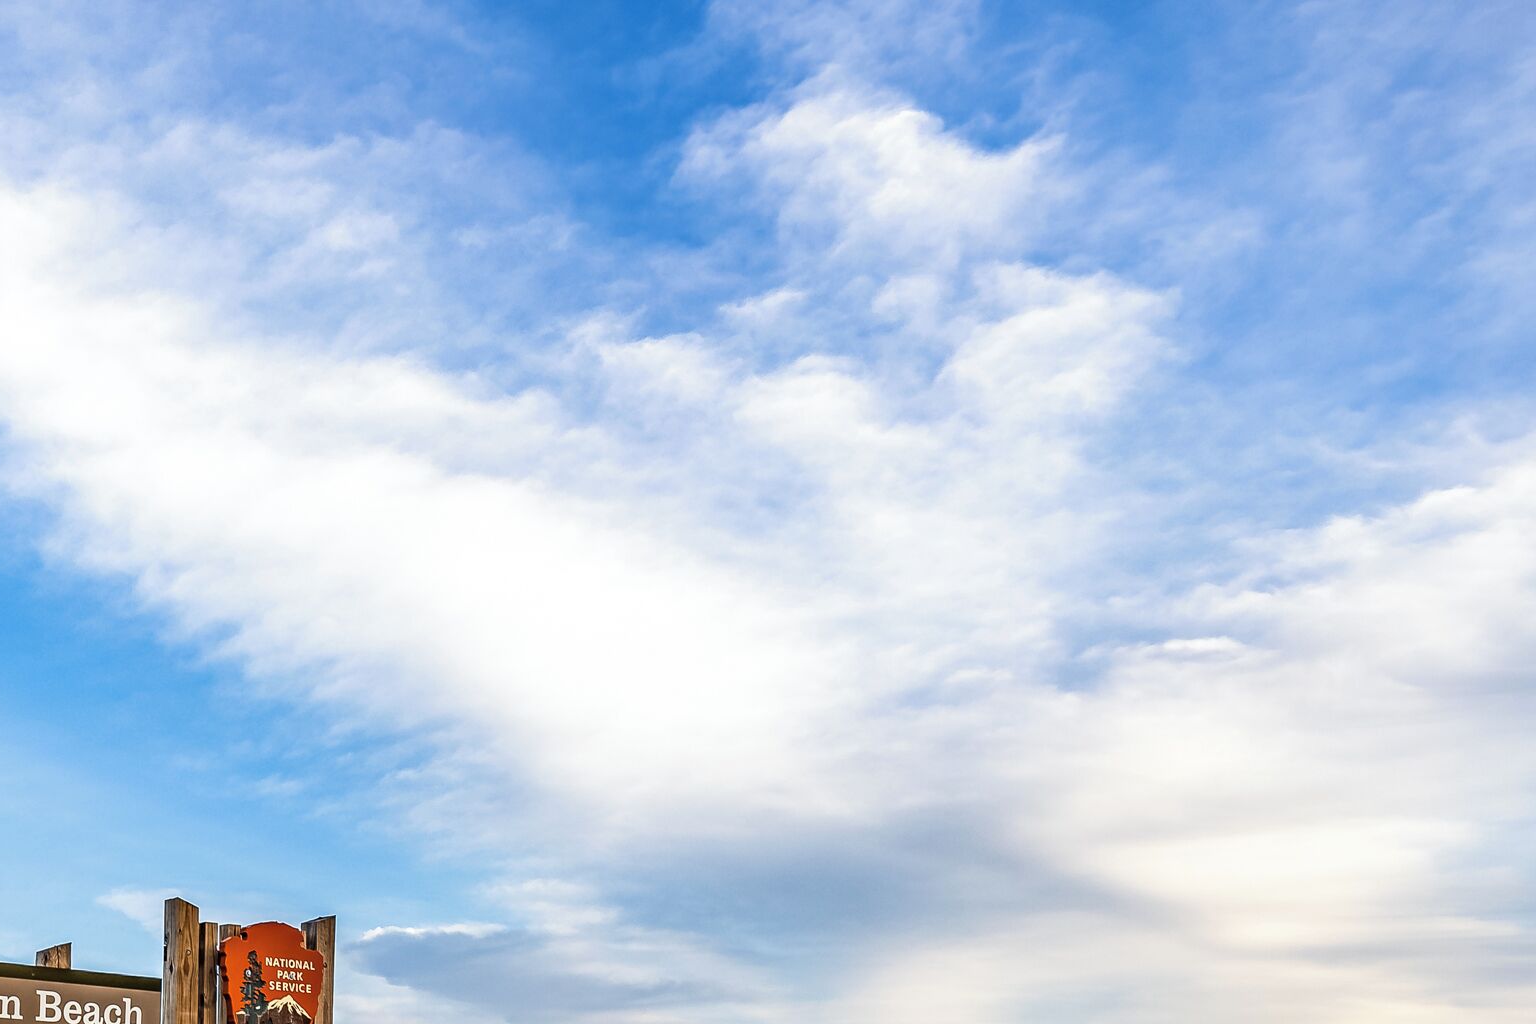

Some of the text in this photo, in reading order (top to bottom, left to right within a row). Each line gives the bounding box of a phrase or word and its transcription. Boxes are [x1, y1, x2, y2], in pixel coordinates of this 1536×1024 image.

[265, 957, 315, 970] NATIONAL
[277, 970, 303, 981] PARK
[269, 981, 312, 994] SERVICE
